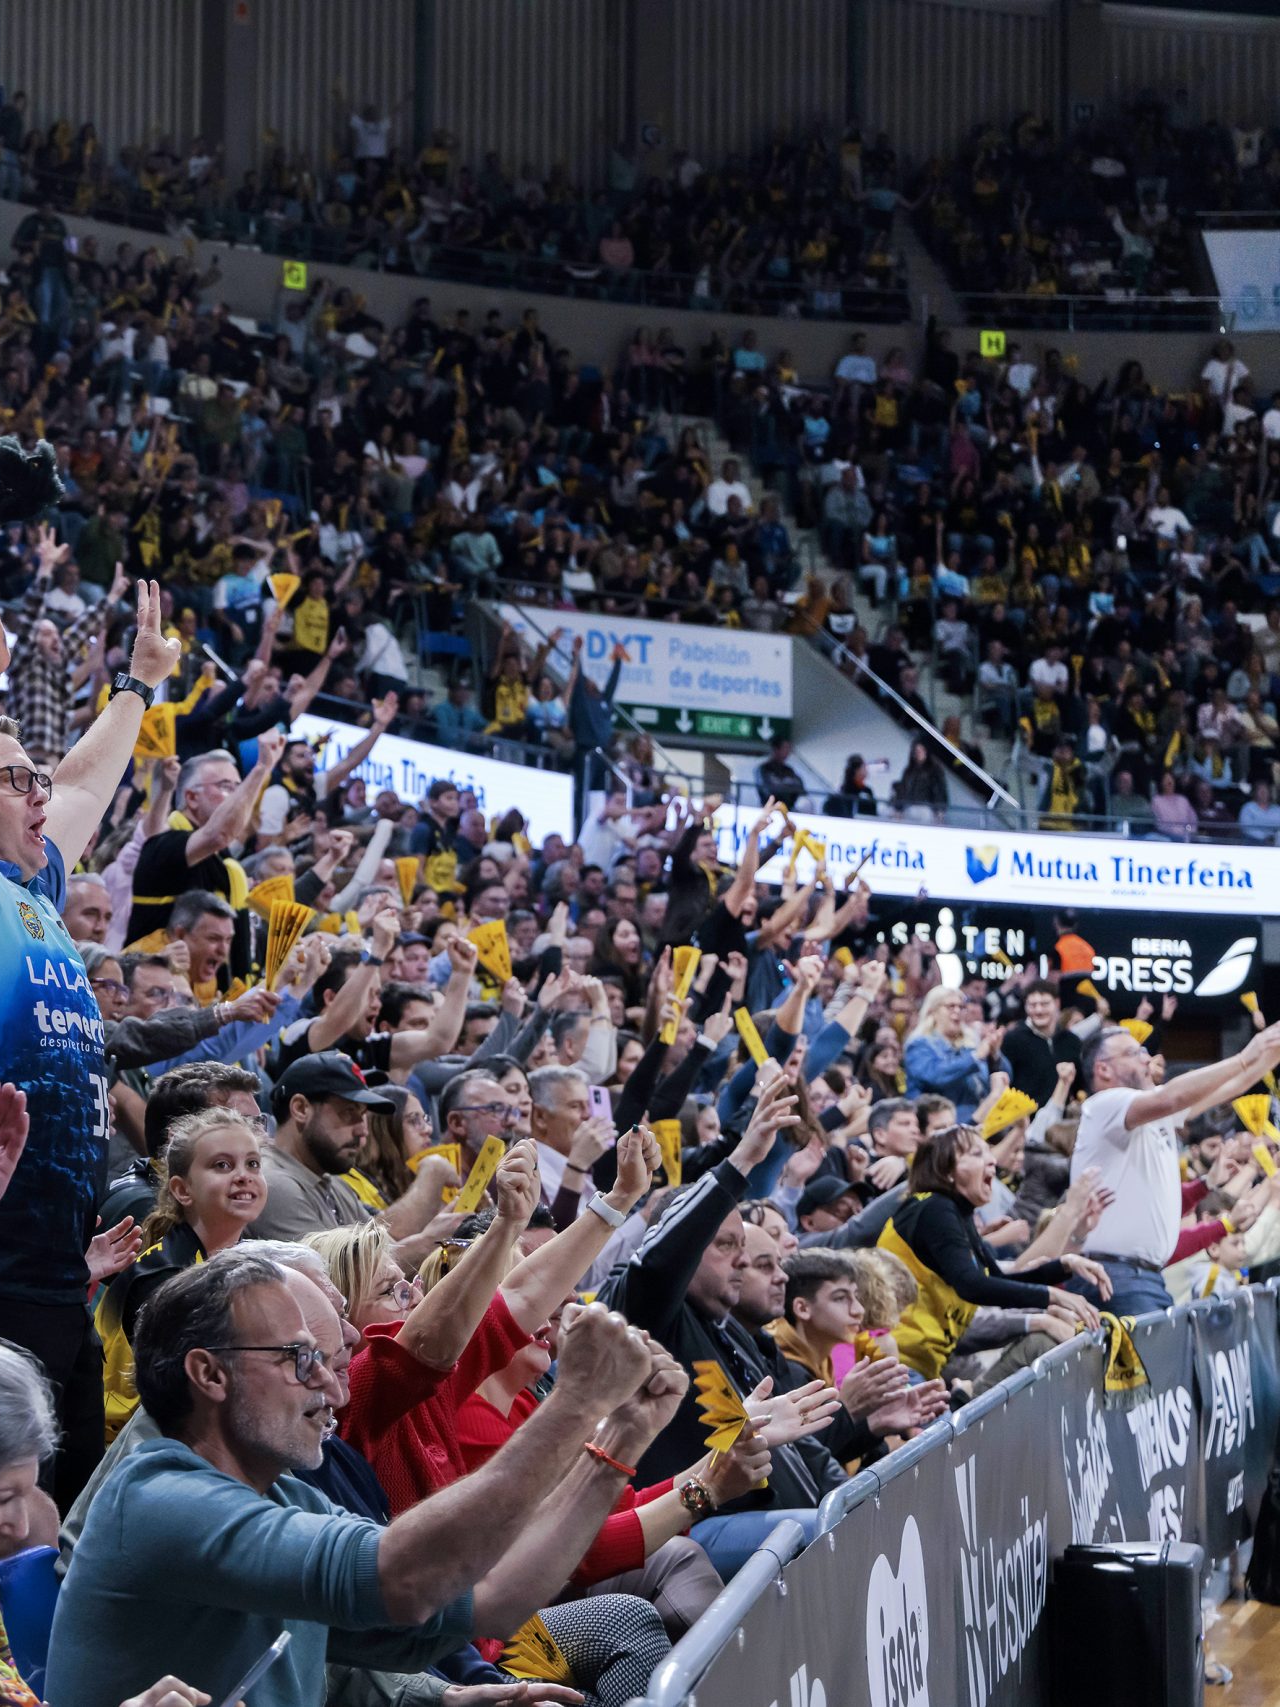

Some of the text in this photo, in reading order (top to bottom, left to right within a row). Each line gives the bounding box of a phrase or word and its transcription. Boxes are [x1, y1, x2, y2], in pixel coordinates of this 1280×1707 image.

[669, 637, 751, 666] Pabellón
[670, 667, 695, 688] de
[698, 669, 782, 697] deportes
[1011, 850, 1253, 888] Mutua Tinerfeña
[1131, 937, 1193, 958] IBERIA
[25, 956, 62, 988] LA
[40, 1035, 90, 1053] despierta
[879, 1581, 925, 1707] isola
